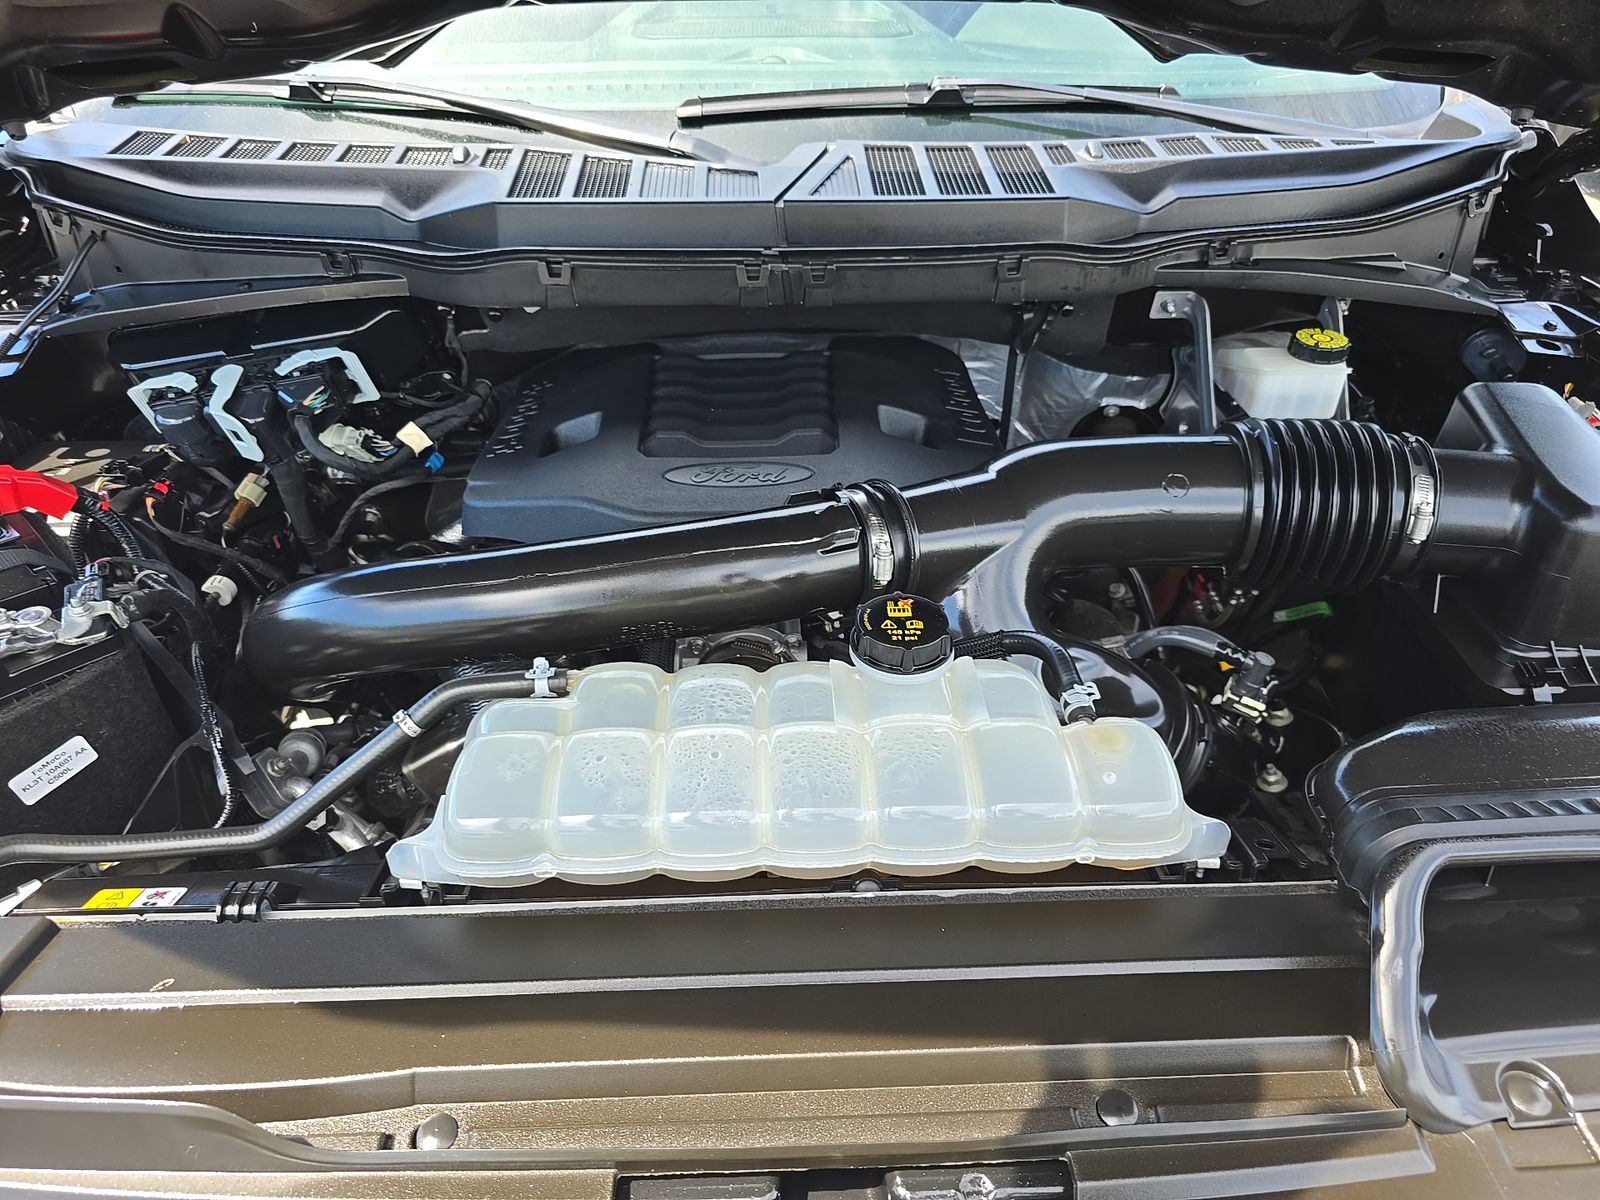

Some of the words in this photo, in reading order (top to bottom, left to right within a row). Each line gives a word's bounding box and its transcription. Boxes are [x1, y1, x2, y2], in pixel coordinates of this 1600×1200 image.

[690, 466, 788, 483] Ford
[21, 776, 44, 793] KL3T
[75, 747, 88, 757] AA
[31, 751, 67, 776] FoMoCo
